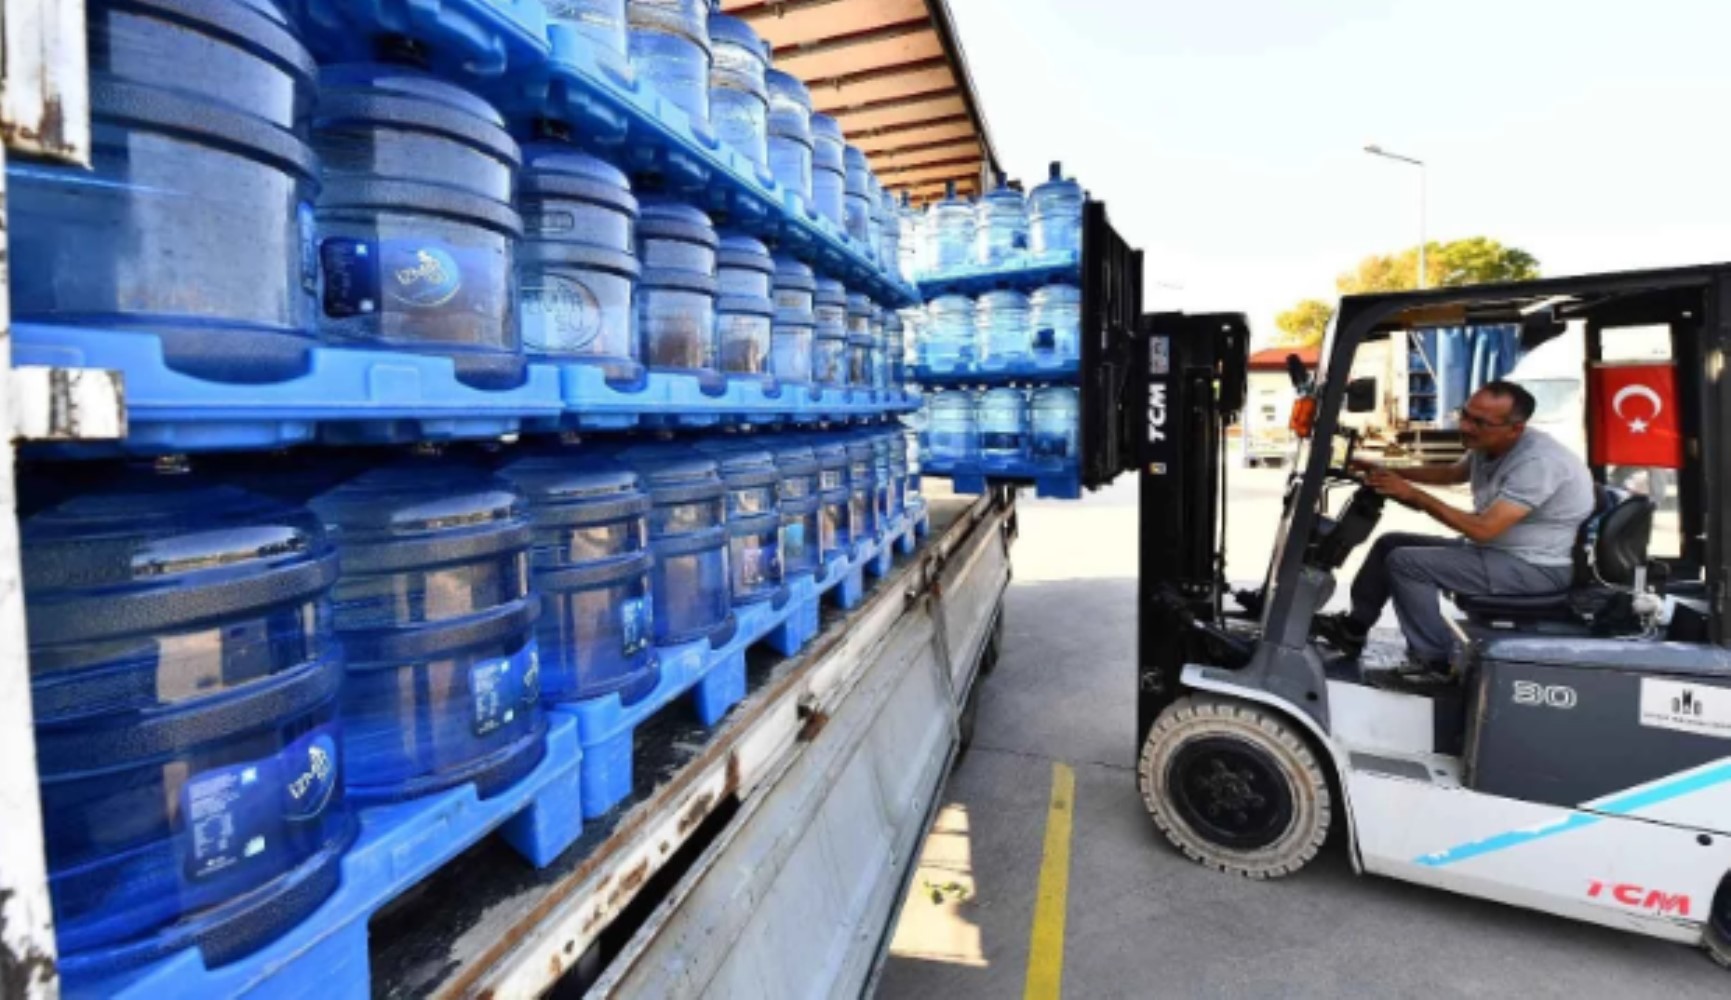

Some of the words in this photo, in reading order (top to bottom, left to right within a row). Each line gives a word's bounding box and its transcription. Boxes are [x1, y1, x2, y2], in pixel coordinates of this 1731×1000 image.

[1148, 382, 1167, 442] TCM
[1513, 679, 1577, 709] 30
[1586, 879, 1690, 916] TCM
